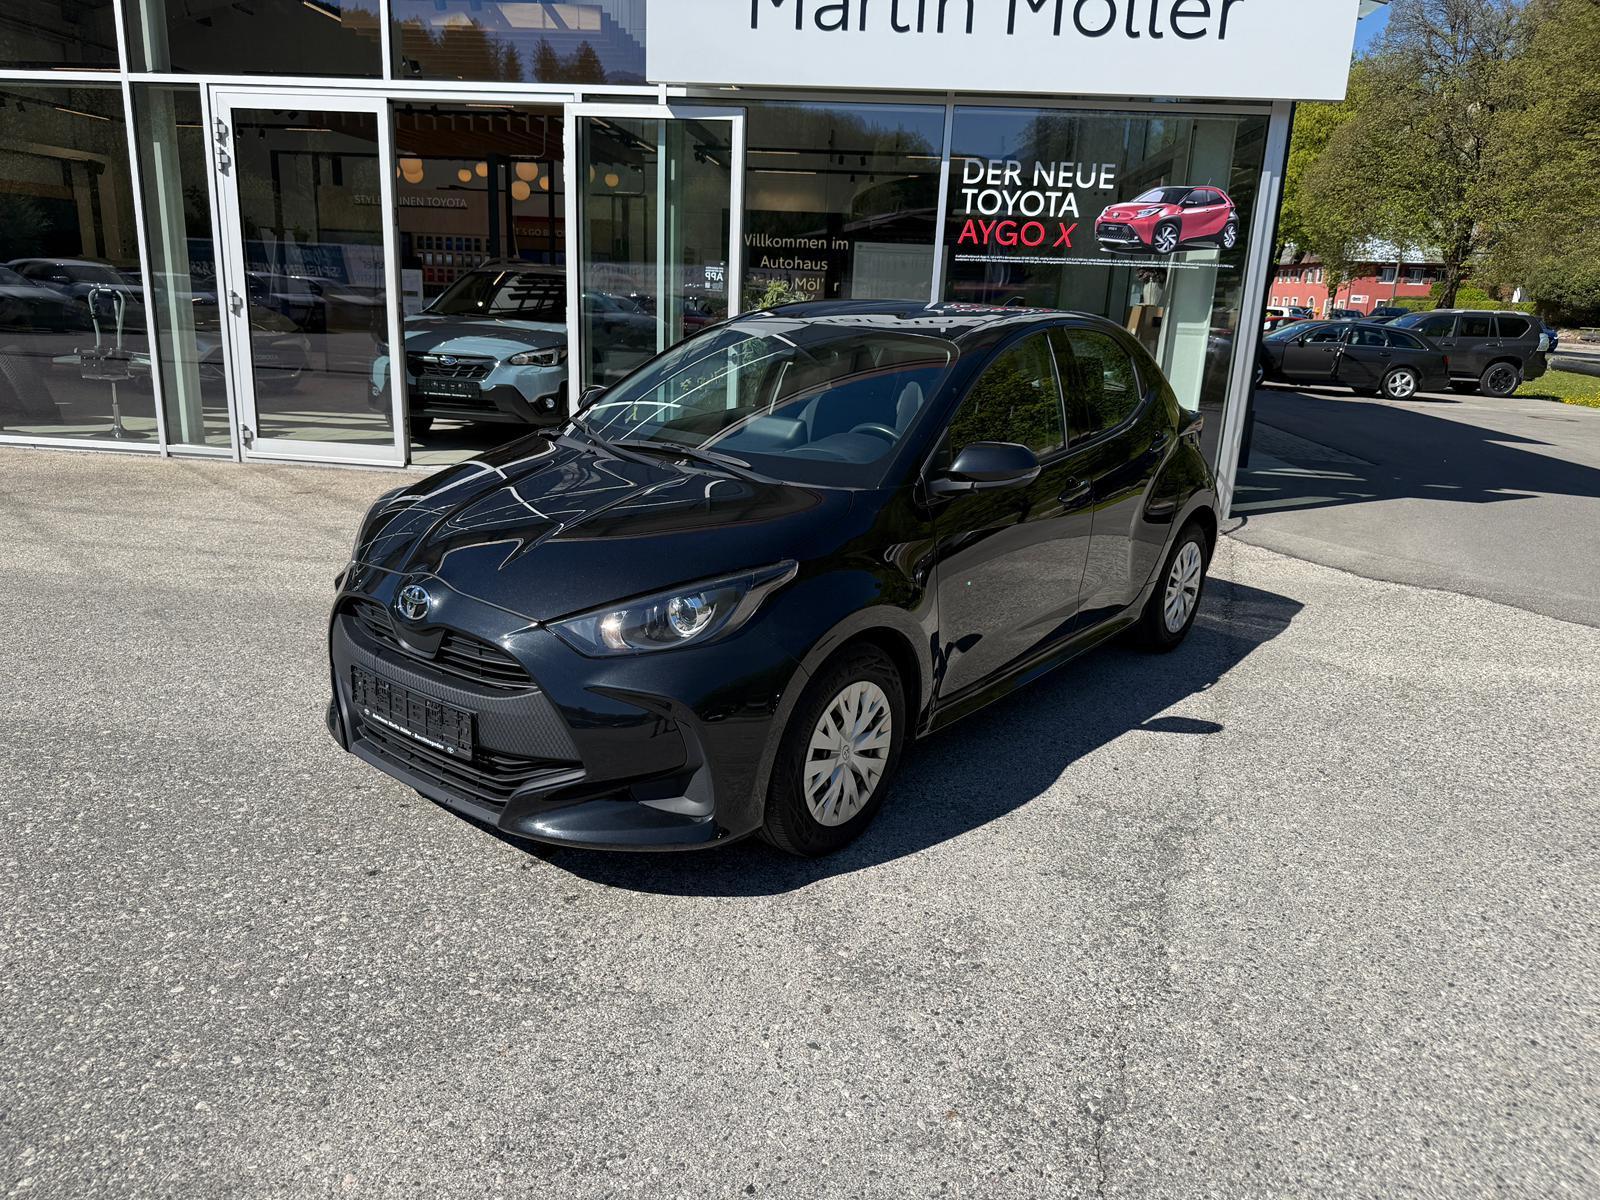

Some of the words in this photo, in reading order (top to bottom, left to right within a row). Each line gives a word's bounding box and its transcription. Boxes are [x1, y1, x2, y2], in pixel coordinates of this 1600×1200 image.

[962, 158, 1022, 186] DER
[1033, 160, 1116, 189] NEUE
[427, 198, 468, 209] TOYOTA
[961, 188, 1080, 219] TOYOTA
[957, 219, 1046, 247] AYGO
[1052, 222, 1079, 248] X
[831, 236, 849, 251] im
[760, 255, 829, 271] Autohaus
[794, 276, 840, 292] Mölr
